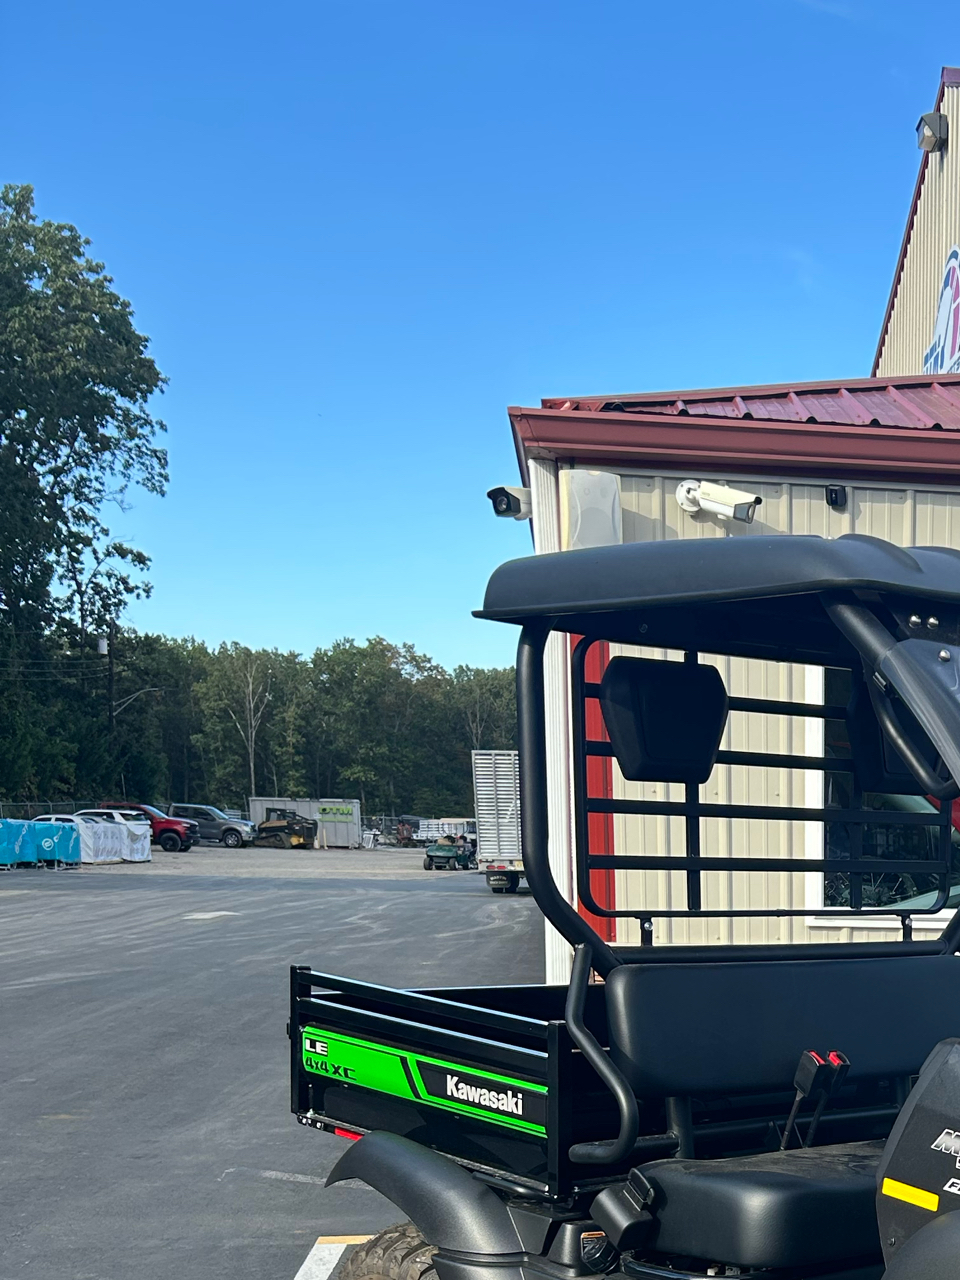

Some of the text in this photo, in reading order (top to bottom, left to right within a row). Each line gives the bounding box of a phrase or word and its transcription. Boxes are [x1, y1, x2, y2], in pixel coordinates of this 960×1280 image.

[319, 806, 353, 816] DTM
[305, 1038, 328, 1056] LE
[305, 1056, 357, 1081] 4x4 XC
[446, 1074, 523, 1116] Kawasaki
